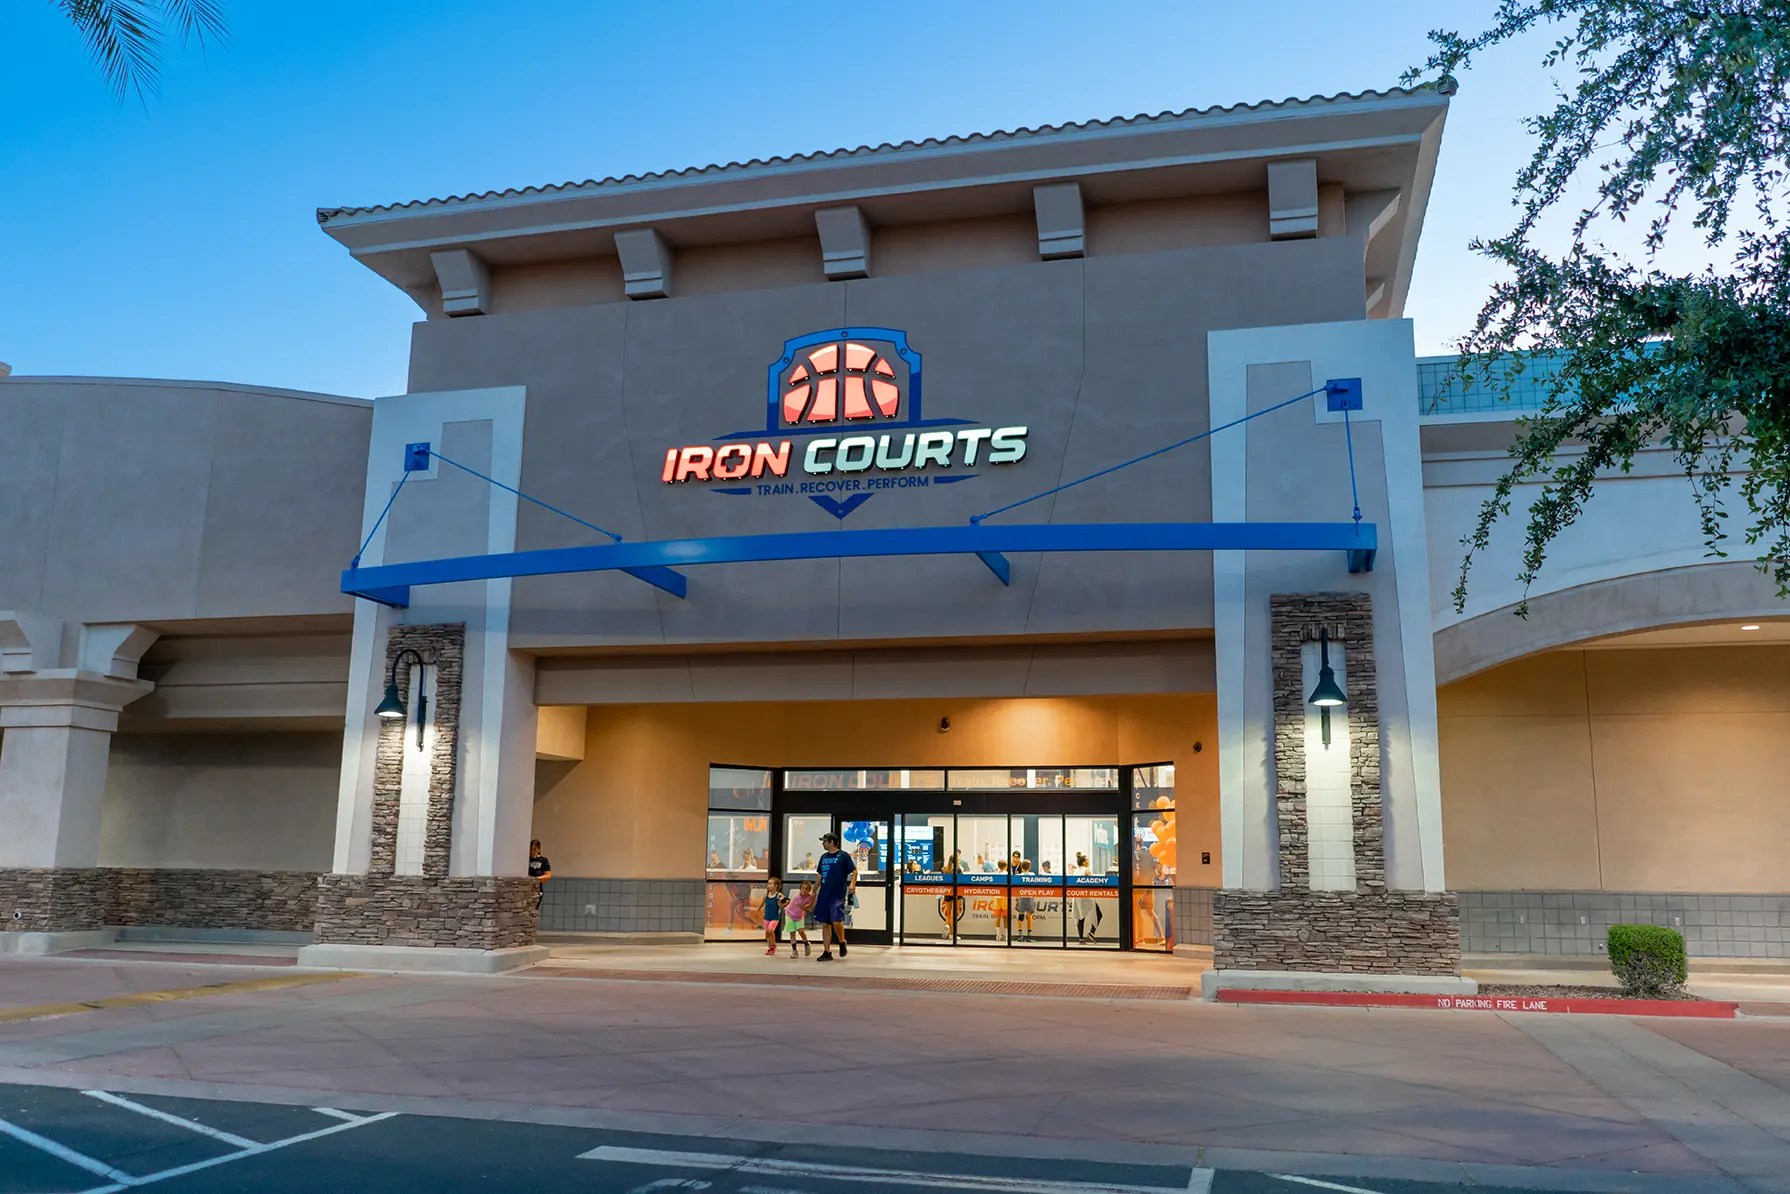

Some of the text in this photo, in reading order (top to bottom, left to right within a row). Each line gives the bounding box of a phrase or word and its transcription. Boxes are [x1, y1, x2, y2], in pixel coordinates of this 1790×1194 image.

[661, 426, 1028, 483] IRON COURTS
[867, 476, 929, 490] PERFORM
[1438, 998, 1548, 1011] NO PARKING FIRE LANE
